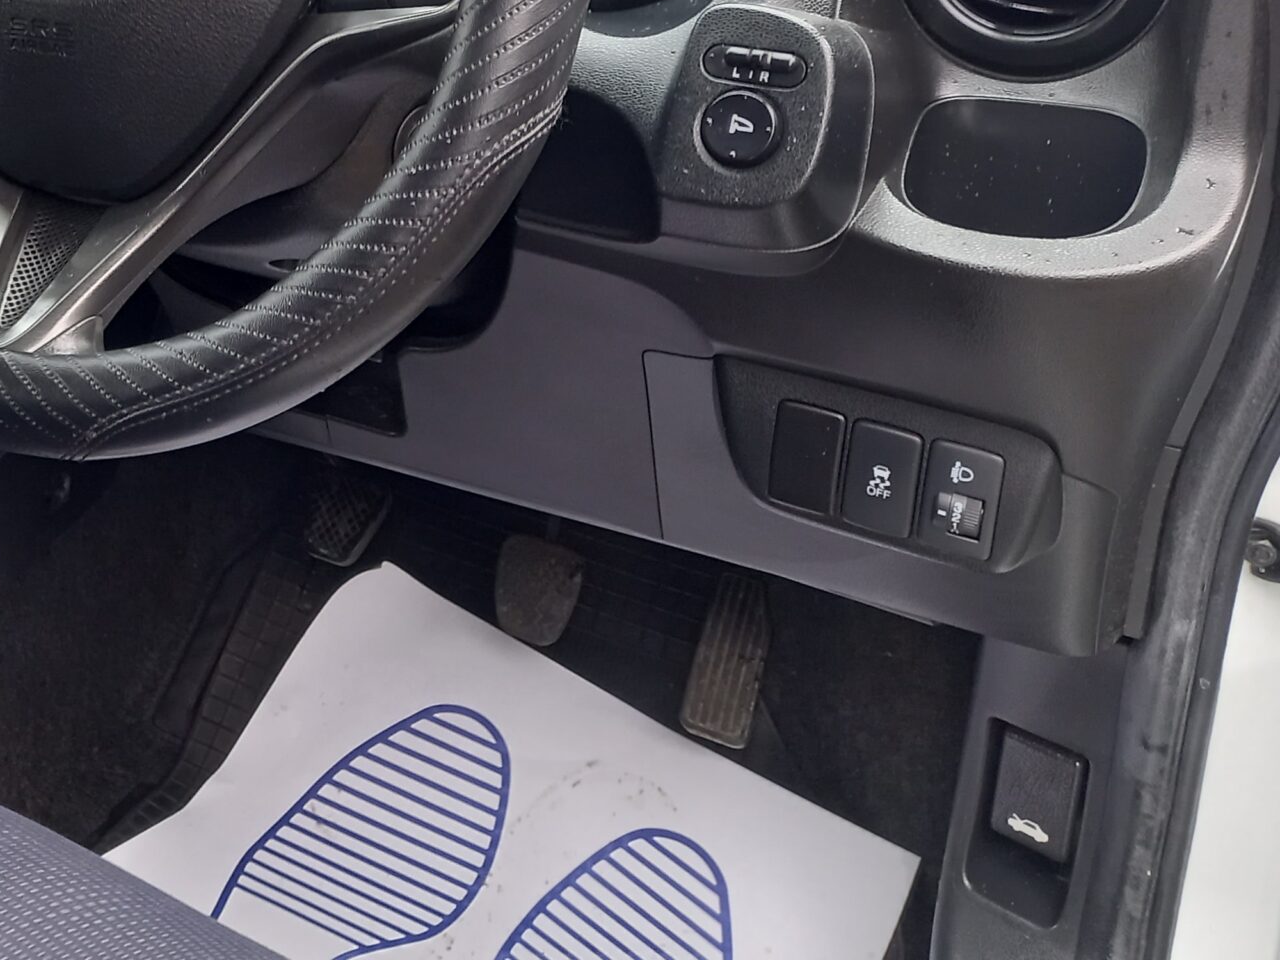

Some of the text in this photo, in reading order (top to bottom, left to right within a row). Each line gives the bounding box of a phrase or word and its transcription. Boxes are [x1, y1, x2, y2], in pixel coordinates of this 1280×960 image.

[732, 66, 770, 83] L R
[866, 485, 892, 499] OFF
[953, 502, 963, 513] 3
[951, 512, 962, 523] 2
